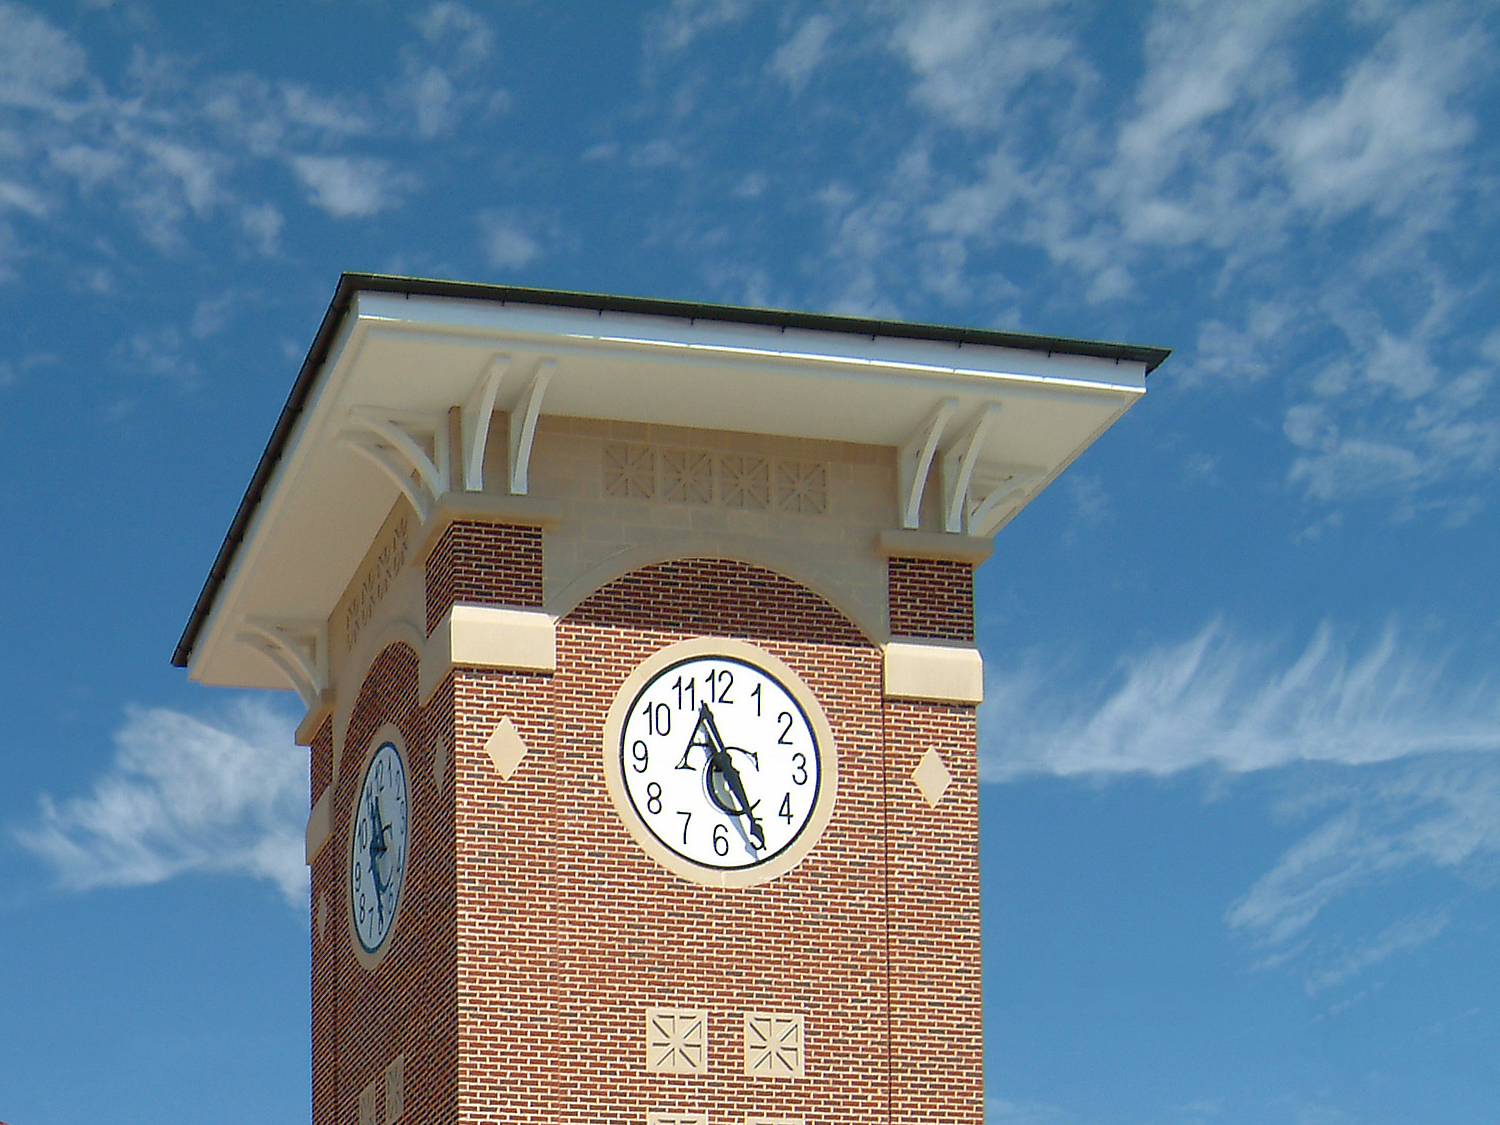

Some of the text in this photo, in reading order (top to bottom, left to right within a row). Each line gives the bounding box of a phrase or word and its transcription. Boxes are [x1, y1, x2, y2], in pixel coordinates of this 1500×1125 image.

[672, 676, 695, 711] 11
[705, 669, 734, 704] 12
[751, 683, 761, 717] 1
[643, 701, 671, 736] 10
[777, 711, 794, 745] 2
[632, 740, 649, 773] 9
[792, 753, 808, 786] 3
[647, 782, 662, 815] 8
[778, 792, 794, 825] 4
[676, 811, 692, 844] 7
[712, 824, 729, 857] 6
[355, 862, 361, 892] 9
[360, 893, 365, 924] 8
